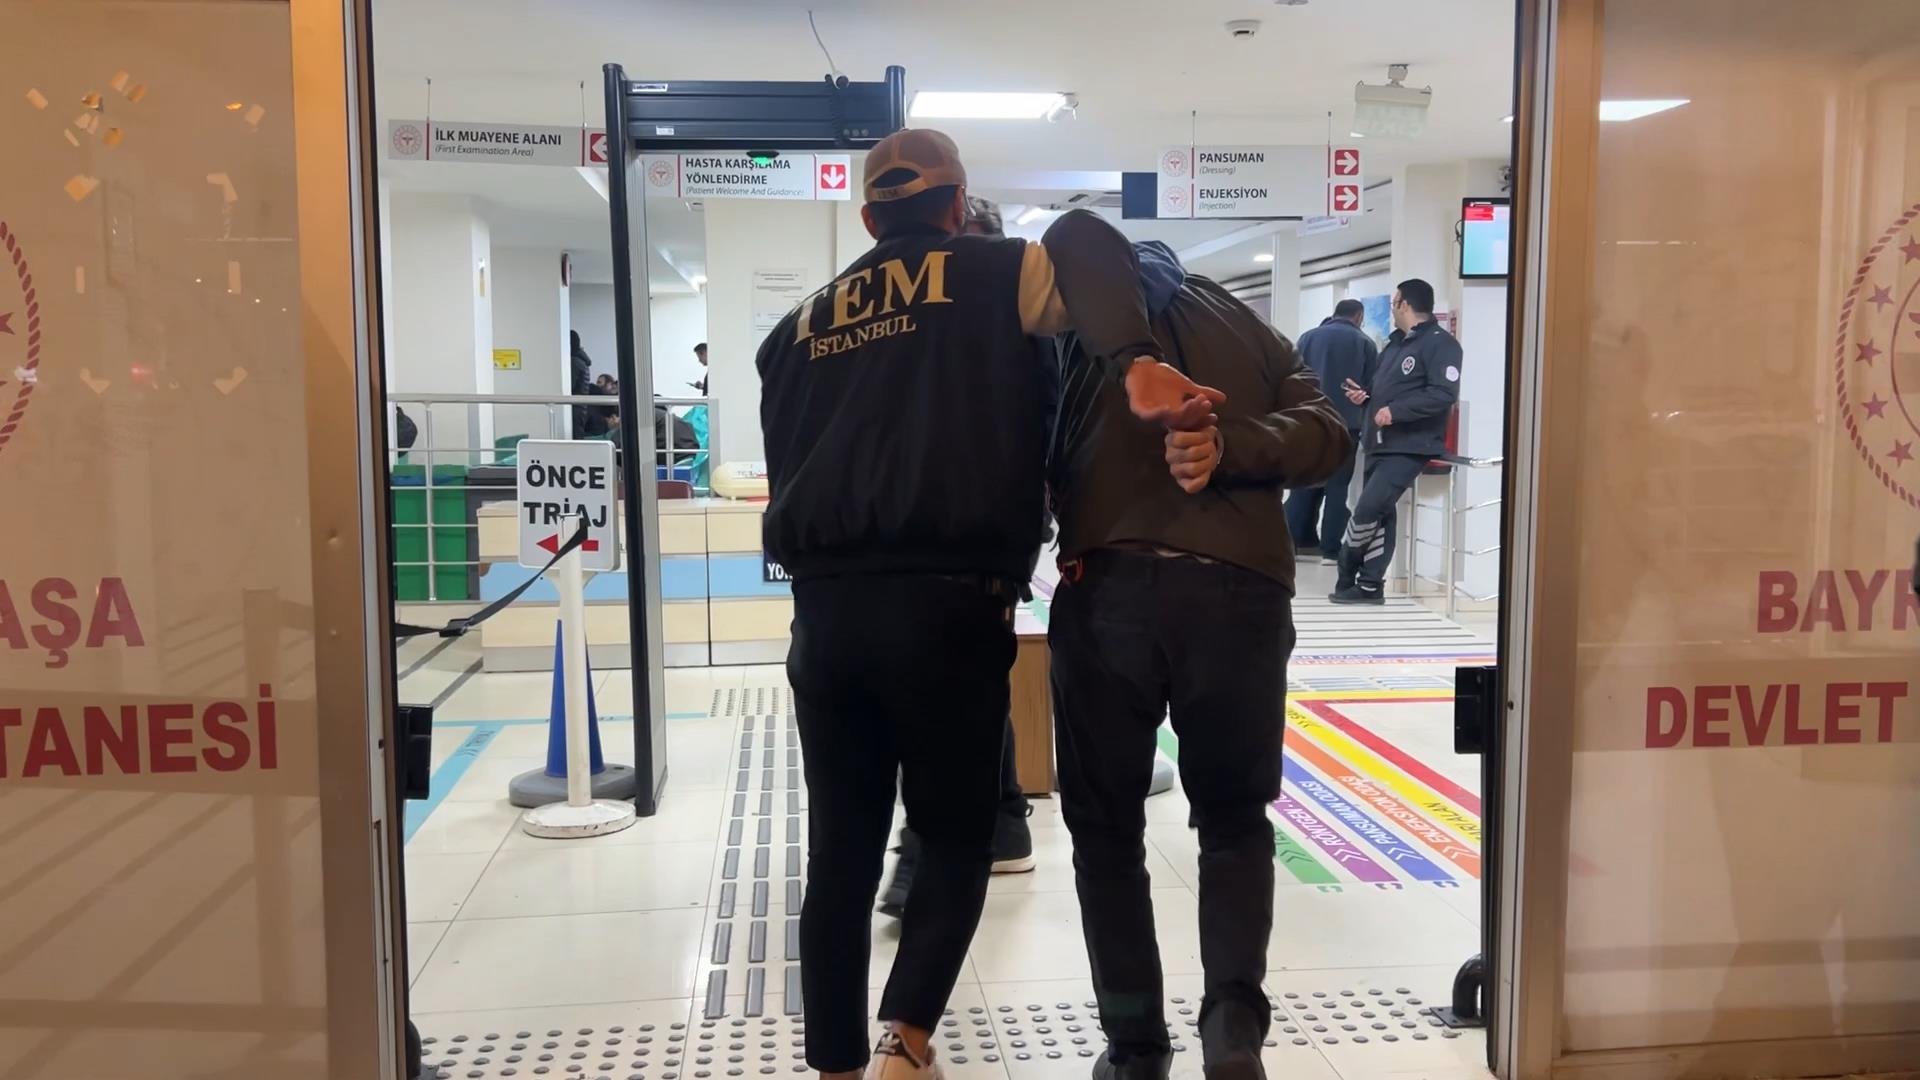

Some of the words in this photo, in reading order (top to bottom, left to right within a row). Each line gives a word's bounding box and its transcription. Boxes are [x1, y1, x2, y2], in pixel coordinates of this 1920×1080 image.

[435, 128, 455, 141] İLK
[458, 130, 519, 144] MUAYENE
[522, 133, 561, 146] ALANI
[435, 144, 456, 154] (First
[457, 145, 509, 156] Examination
[510, 148, 534, 157] Area)
[686, 158, 722, 168] HASTA
[1199, 153, 1264, 163] PANSUMAN
[686, 171, 767, 185] YÖNLENDİRME
[1199, 166, 1236, 176] (Dressing)
[686, 186, 715, 196] (Patient
[715, 187, 750, 196] Welcome
[750, 188, 766, 196] And
[1199, 187, 1268, 199] ENJEKSİYON
[1199, 201, 1236, 211] (Injection)
[793, 251, 954, 345] TEM
[809, 315, 917, 361] İSTANBUL
[526, 459, 605, 490] ÖNCE
[523, 498, 607, 528] TRİAJ
[1645, 682, 1908, 748] DEVLET
[1326, 802, 1399, 845] PANSUMAN
